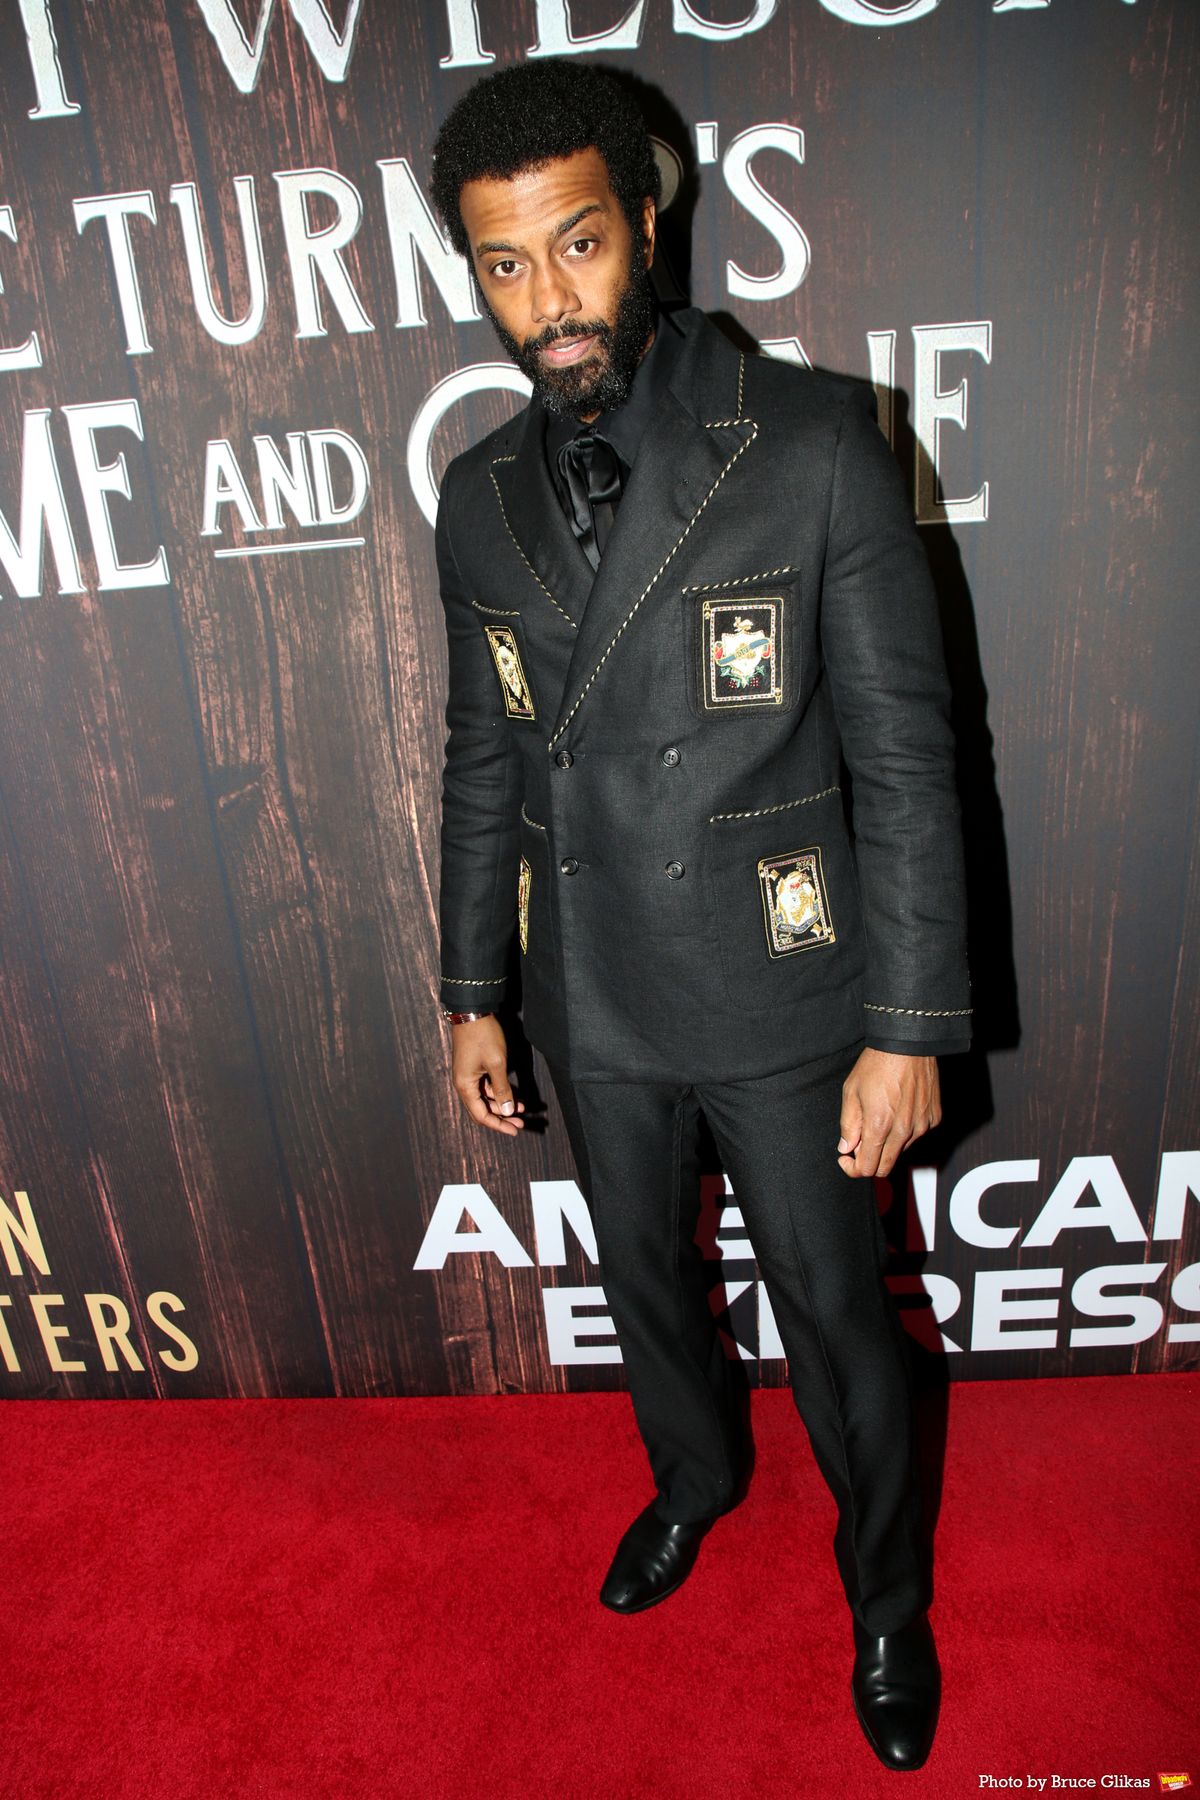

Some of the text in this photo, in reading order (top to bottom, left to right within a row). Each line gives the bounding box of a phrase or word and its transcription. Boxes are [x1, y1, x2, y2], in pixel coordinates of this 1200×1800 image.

[73, 122, 811, 355] TURN'S
[200, 428, 371, 536] AND
[413, 1151, 1200, 1270] AEICA
[543, 1262, 1200, 1367] ERES
